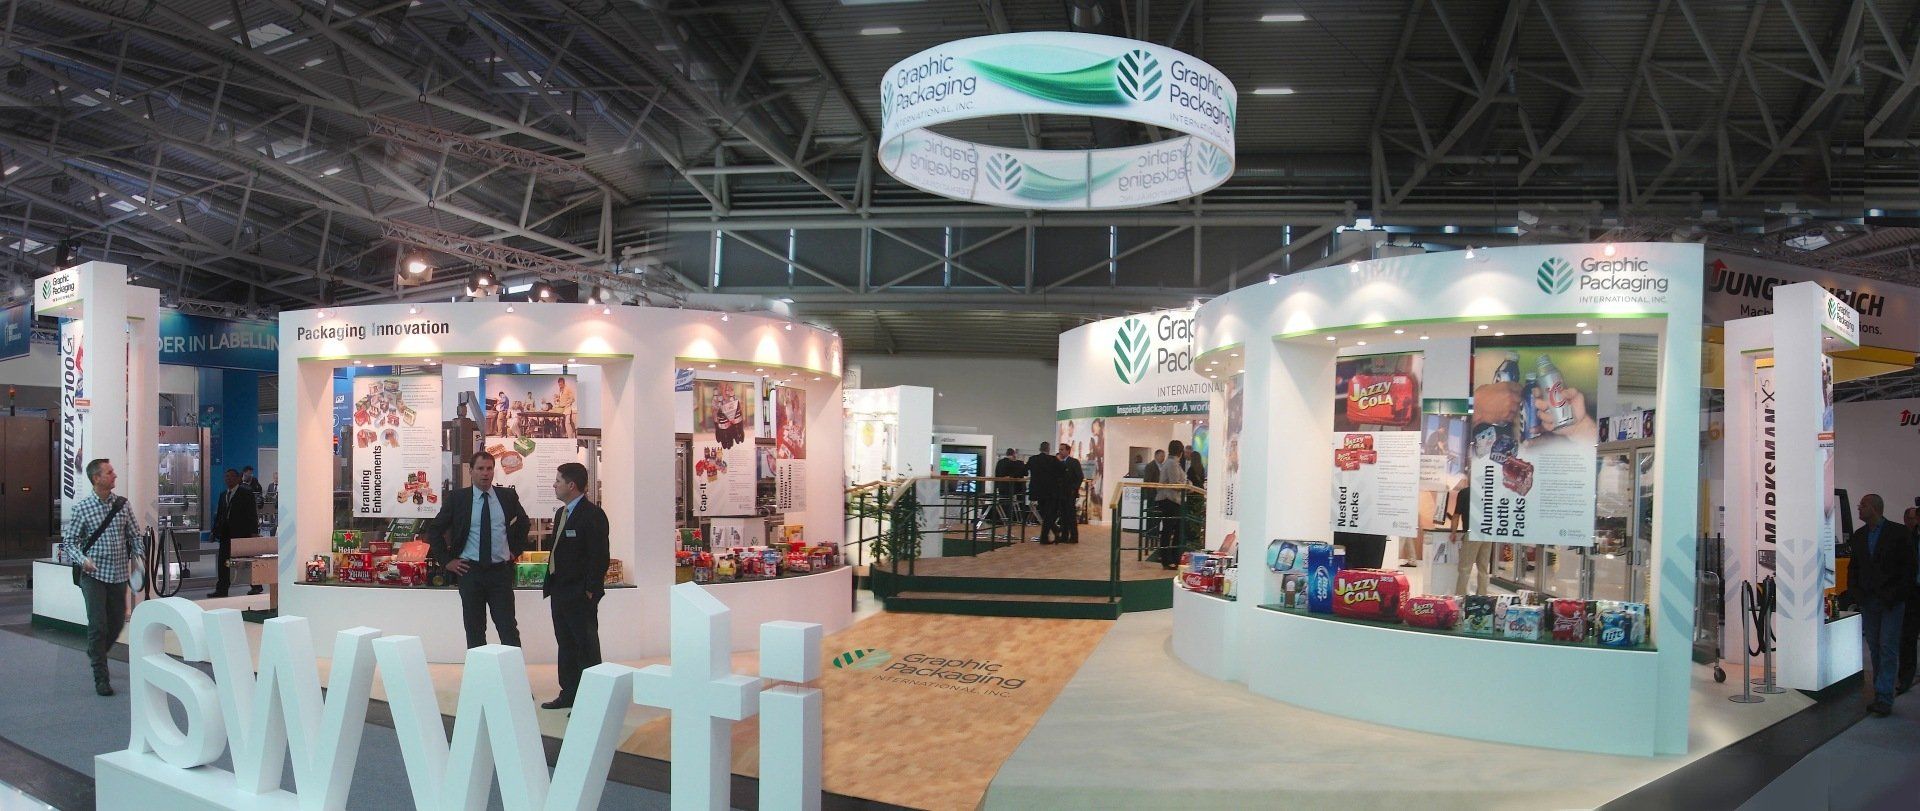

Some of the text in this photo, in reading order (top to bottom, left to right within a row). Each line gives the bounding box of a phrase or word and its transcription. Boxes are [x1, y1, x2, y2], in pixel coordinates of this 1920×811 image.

[897, 54, 954, 89] Graphic
[1171, 60, 1223, 100] Graphic
[896, 76, 977, 113] Packaging
[1170, 84, 1231, 133] Packaging
[52, 274, 70, 286] Graphic
[1580, 257, 1648, 274] Graphic
[52, 282, 75, 296] Packaging
[1580, 275, 1669, 293] Packaging
[189, 335, 206, 352] IN
[297, 320, 449, 341] Packaging Innovation
[1117, 405, 1141, 416] Inspired
[1142, 403, 1180, 415] packaging.
[1182, 403, 1188, 411] A
[1359, 394, 1393, 410] COLA
[63, 412, 75, 500] QUIKFLEX
[361, 470, 371, 514] Branding
[373, 445, 382, 514] Enhancements
[1337, 486, 1347, 527] Nested
[1350, 491, 1360, 528] Packs
[1480, 465, 1494, 536] Aluminium
[1497, 497, 1510, 537] Bottle
[1512, 497, 1526, 538] Packs
[1344, 590, 1382, 605] COLA
[885, 662, 1026, 690] Packaging
[903, 652, 1003, 672] Graphic
